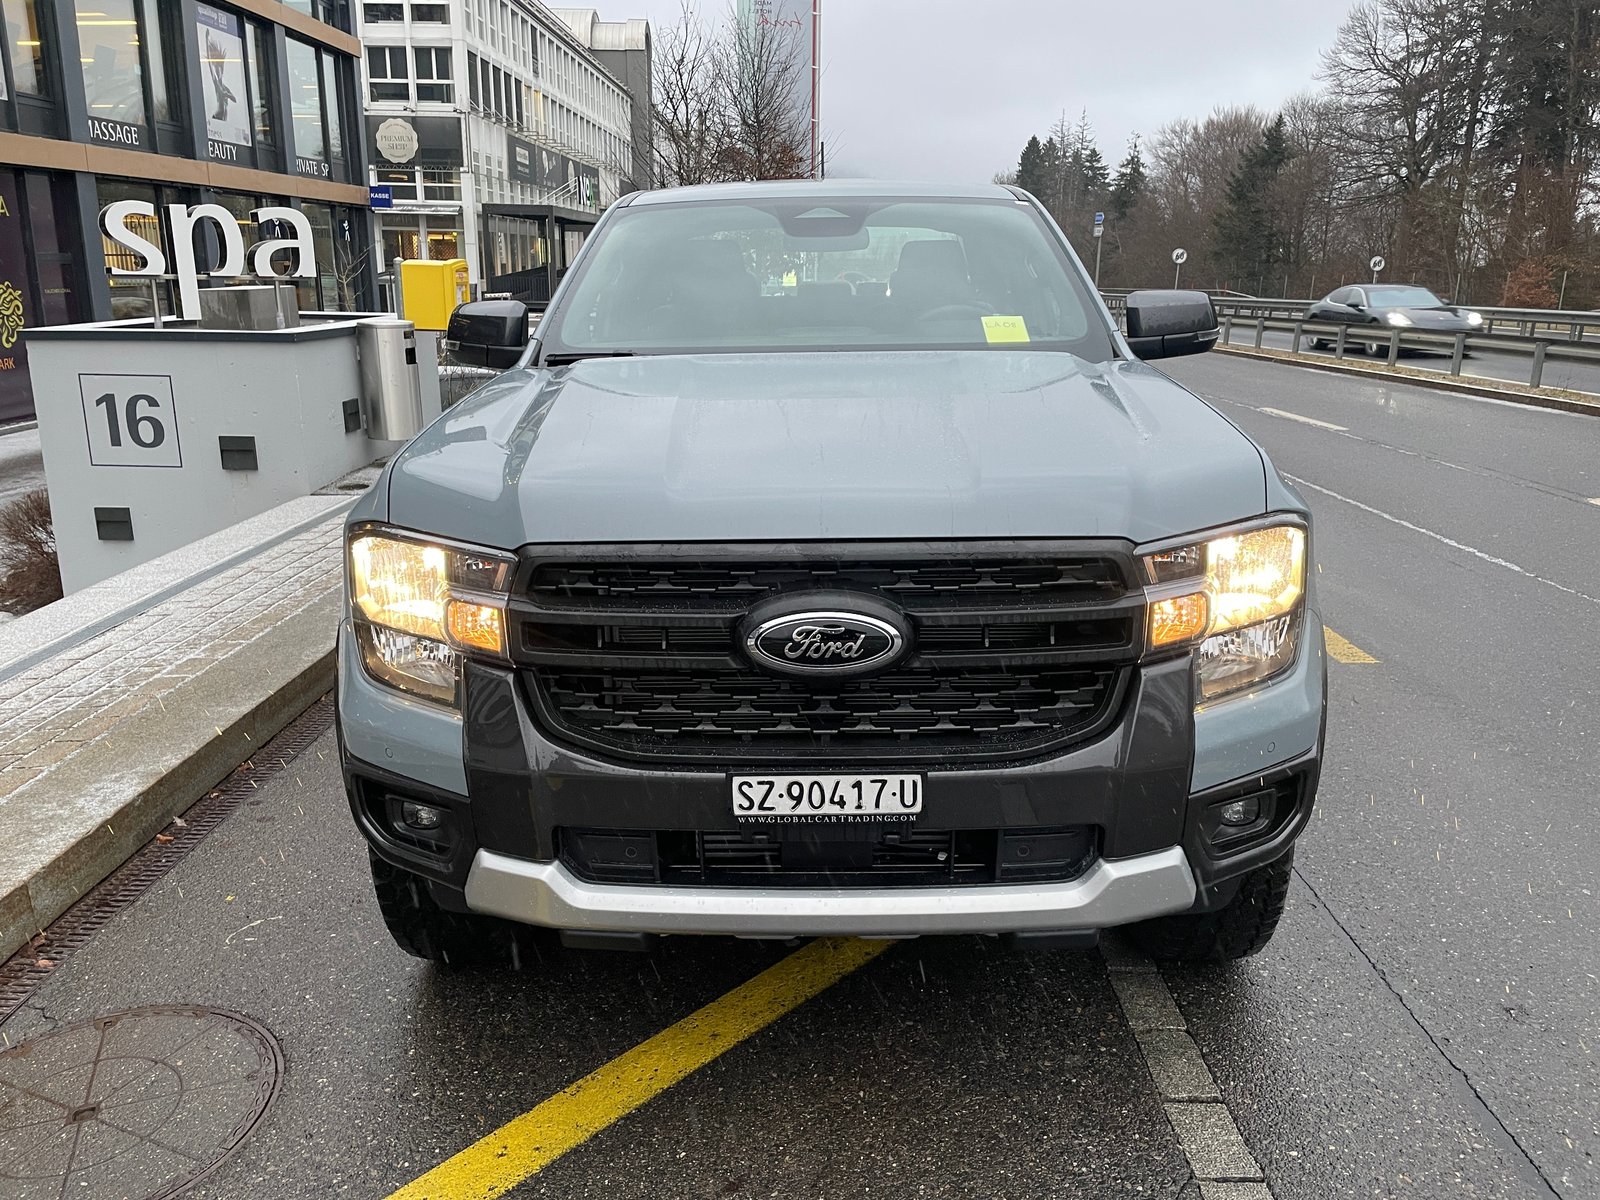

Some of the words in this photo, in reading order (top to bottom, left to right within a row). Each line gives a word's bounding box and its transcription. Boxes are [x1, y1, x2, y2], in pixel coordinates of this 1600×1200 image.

[88, 119, 140, 146] ASSAGE
[208, 141, 237, 161] EAUTY
[320, 162, 330, 177] SP
[98, 199, 317, 320] spa
[96, 393, 165, 449] 16
[784, 625, 866, 659] Ford
